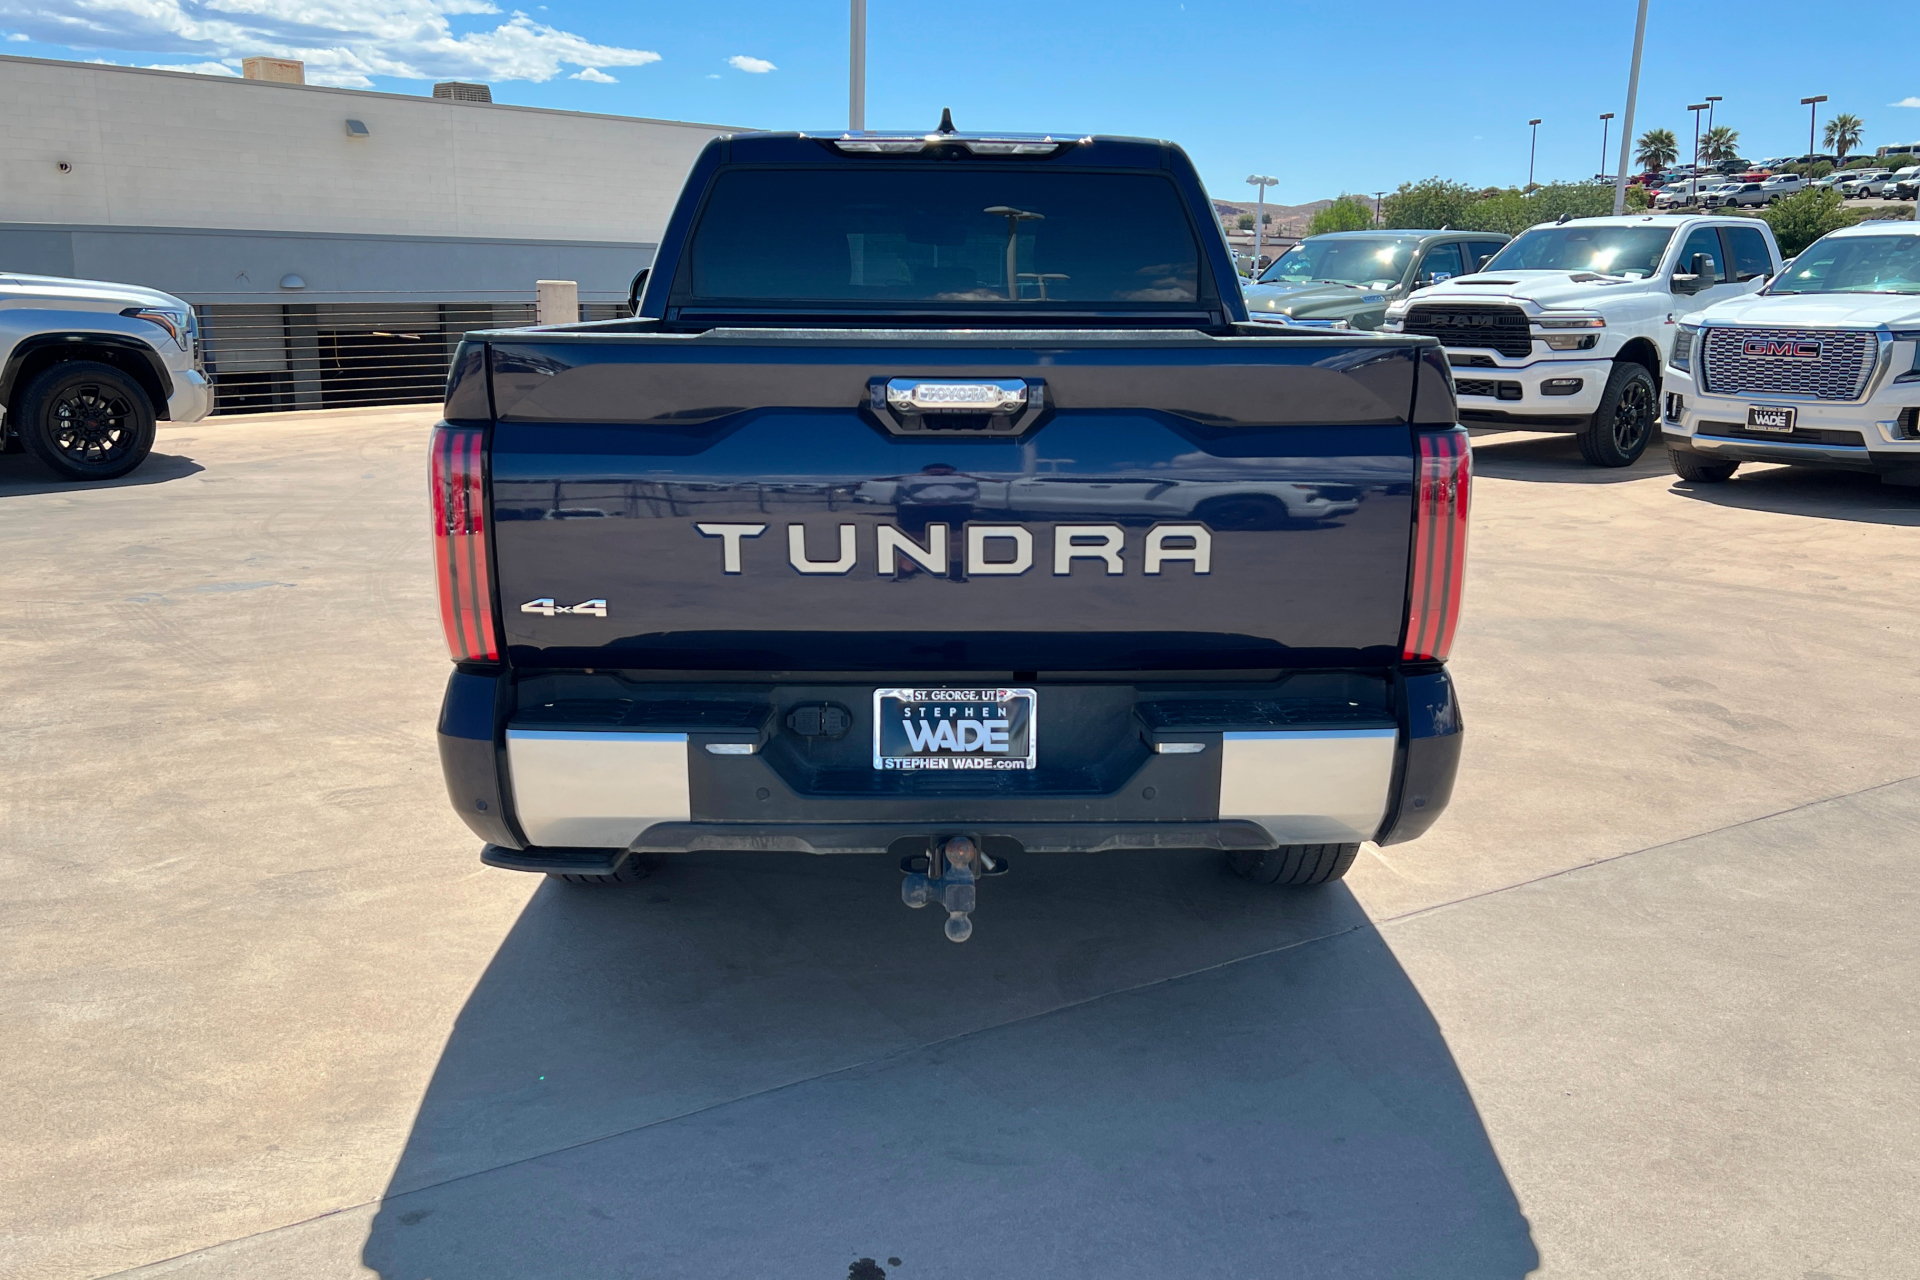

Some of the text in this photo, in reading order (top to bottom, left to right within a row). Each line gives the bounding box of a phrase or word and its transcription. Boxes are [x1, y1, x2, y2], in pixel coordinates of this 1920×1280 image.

[1430, 314, 1494, 326] RAM
[1744, 341, 1819, 357] GMC
[924, 387, 989, 400] TOYOTA
[1754, 414, 1786, 426] WADE
[696, 522, 1212, 575] TUNDRA
[521, 598, 608, 617] 4x4
[914, 690, 996, 701] ST. GEORGE, UT
[904, 707, 1007, 717] STEPHEN
[902, 719, 1009, 752] WADE
[884, 758, 1025, 769] STEPHEN WADE.com
